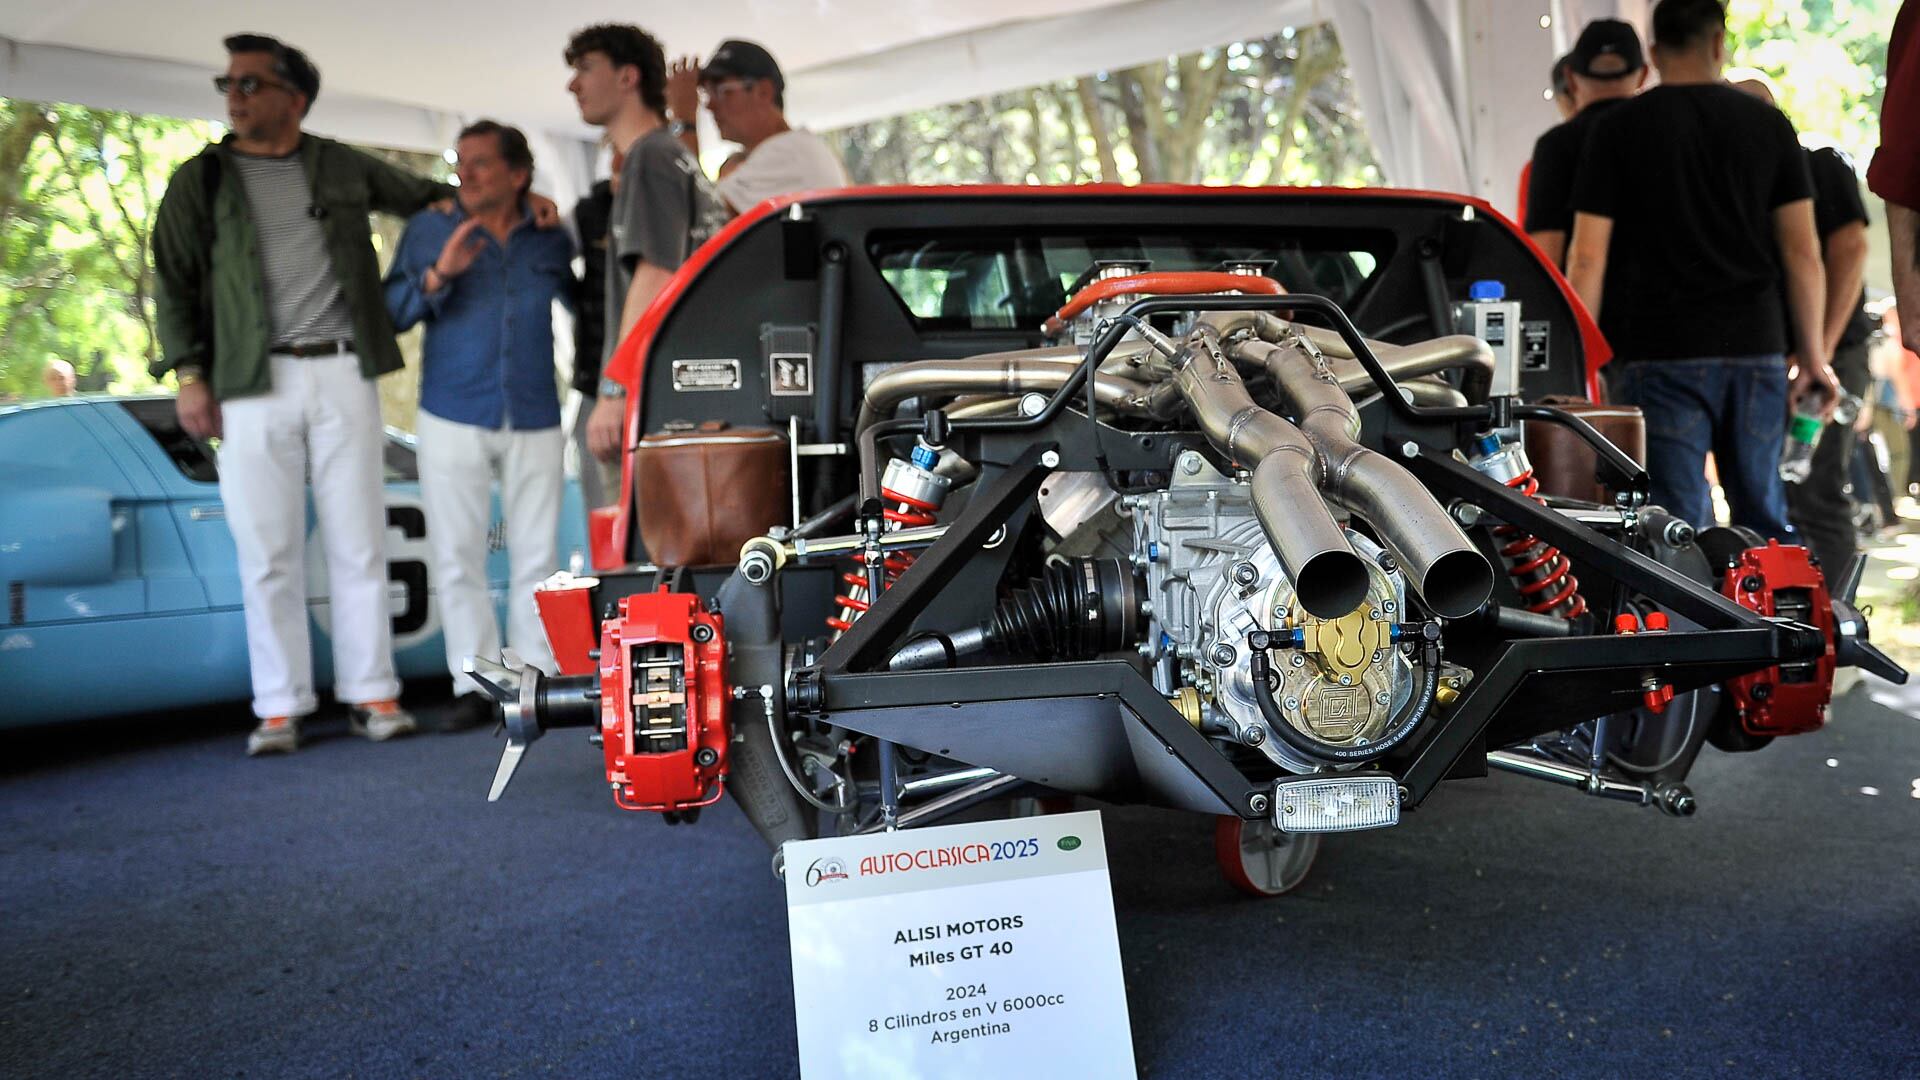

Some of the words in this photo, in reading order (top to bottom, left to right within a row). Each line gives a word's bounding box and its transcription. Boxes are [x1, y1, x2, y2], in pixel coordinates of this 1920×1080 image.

[1375, 741, 1393, 752] HOSE
[894, 925, 941, 944] ALISI
[946, 915, 1024, 937] MOTORS
[909, 951, 955, 967] Miles
[960, 945, 984, 960] GT
[989, 941, 1013, 955] 40
[946, 983, 987, 1001] 2024
[868, 1019, 878, 1032] 8
[884, 1011, 957, 1030] Cilindros
[962, 1005, 981, 1019] en
[986, 1001, 997, 1014] V
[1003, 994, 1065, 1012] 6000cc
[931, 1022, 1011, 1044] Argentina
